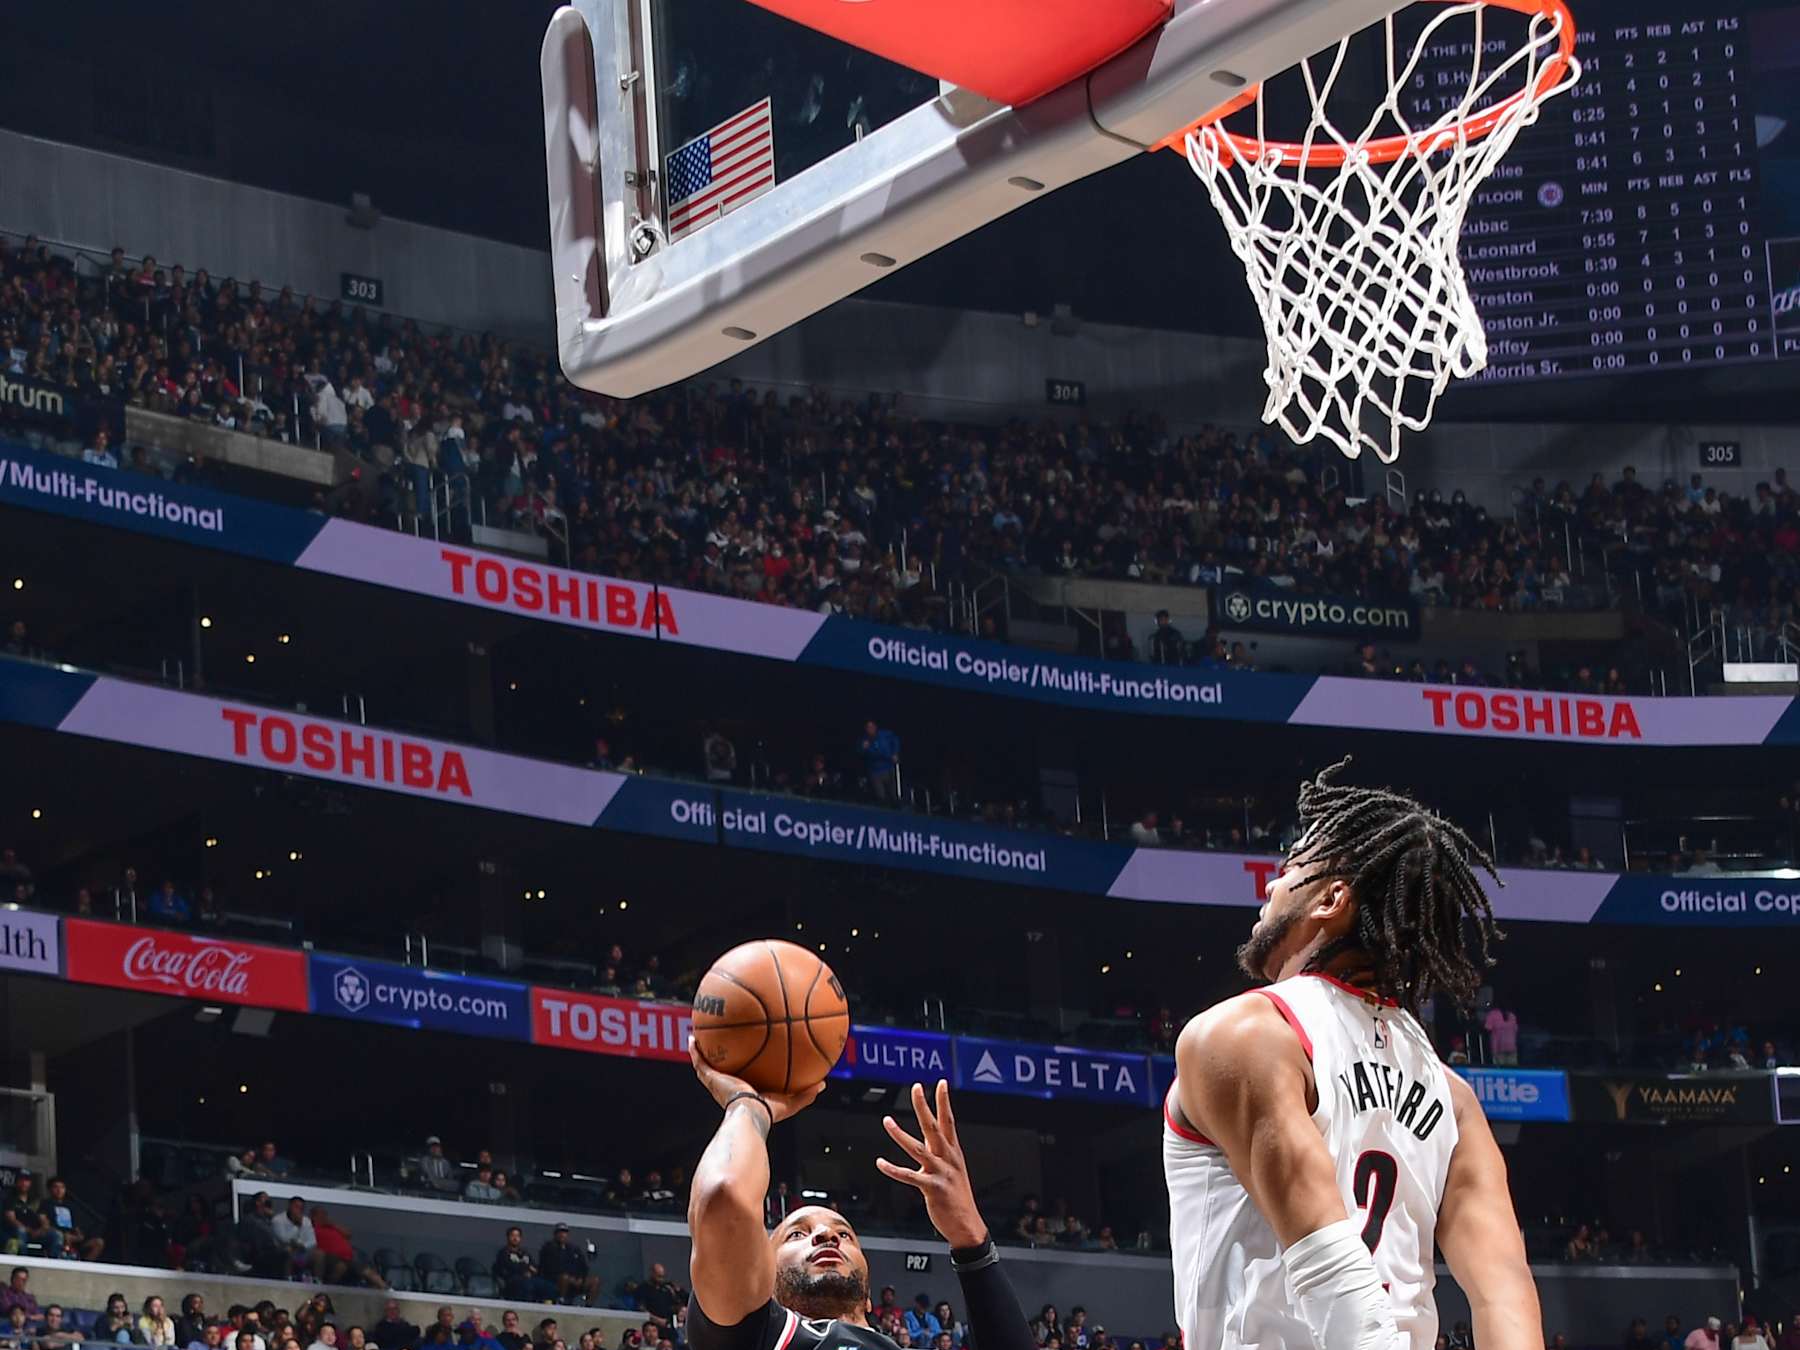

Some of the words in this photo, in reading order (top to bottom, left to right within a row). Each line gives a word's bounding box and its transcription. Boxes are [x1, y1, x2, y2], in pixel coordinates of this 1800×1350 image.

[1431, 44, 1459, 57] THE
[1615, 27, 1639, 40] PTS
[1646, 24, 1671, 38] REB
[1681, 21, 1705, 34] AST
[1716, 18, 1739, 31] FLS
[1415, 74, 1425, 88] 5
[1625, 53, 1634, 67] 2
[1657, 51, 1667, 64] 2
[1692, 48, 1700, 61] 1
[1725, 44, 1734, 57] 0
[1414, 99, 1431, 113] 14
[1627, 79, 1636, 92] 4
[1659, 75, 1668, 88] 0
[1693, 72, 1701, 86] 2
[1728, 69, 1735, 82] 1
[1573, 107, 1605, 123] 6:25
[1629, 104, 1638, 117] 3
[1662, 100, 1670, 114] 1
[1694, 97, 1704, 111] 0
[1730, 94, 1737, 107] 1
[1574, 131, 1606, 147] 8:41
[1631, 127, 1640, 141] 7
[1663, 124, 1672, 137] 0
[1696, 121, 1705, 135] 3
[1732, 118, 1739, 131] 1
[1576, 155, 1608, 171] 8:41
[1633, 151, 1642, 165] 6
[1666, 149, 1674, 162] 3
[1699, 146, 1707, 159] 1
[1734, 142, 1741, 156] 1
[1478, 191, 1523, 204] FLOOR
[1581, 182, 1608, 195] MIN
[1627, 178, 1651, 191] PTS
[1658, 174, 1684, 188] REB
[1694, 171, 1718, 185] AST
[1729, 168, 1751, 182] FLS
[1581, 208, 1613, 224] 7:39
[1703, 199, 1712, 213] 0
[1738, 196, 1746, 210] 1
[1459, 240, 1537, 259] .Leonard
[1583, 233, 1615, 249] 9:55
[1639, 230, 1648, 244] 7
[1672, 227, 1680, 241] 1
[1705, 224, 1714, 238] 3
[1739, 221, 1749, 235] 0
[1585, 256, 1617, 273] 8:39
[1641, 253, 1650, 267] 4
[1674, 250, 1683, 264] 3
[1708, 248, 1715, 262] 1
[1741, 245, 1751, 259] 0
[348, 279, 377, 299] 303
[1472, 290, 1533, 307] Preston
[1586, 281, 1619, 297] 0:00
[1643, 278, 1652, 293] 0
[1676, 275, 1686, 289] 0
[1709, 272, 1718, 287] 0
[1743, 269, 1753, 283] 0
[1539, 312, 1559, 327] Jr.
[1588, 306, 1621, 322] 0:00
[1645, 303, 1654, 317] 0
[1678, 300, 1687, 314] 0
[1711, 297, 1721, 311] 0
[1746, 294, 1755, 308] 0
[1590, 330, 1623, 346] 0:00
[1647, 327, 1657, 342] 0
[1680, 324, 1689, 339] 0
[1713, 321, 1723, 336] 0
[1748, 318, 1757, 333] 0
[1540, 359, 1562, 375] Sr.
[1592, 354, 1625, 370] 0:00
[1649, 351, 1659, 366] 0
[1682, 348, 1692, 363] 0
[1715, 345, 1725, 360] 0
[1750, 342, 1759, 357] 0
[0, 374, 63, 415] trum
[1053, 384, 1080, 401] 304
[1707, 447, 1734, 462] 305
[441, 549, 680, 635] TOSHIBA
[1256, 599, 1409, 629] crypto.com
[868, 636, 949, 670] Official
[1422, 689, 1642, 740] TOSHIBA
[222, 708, 473, 797] TOSHIBA
[671, 798, 766, 834] Official
[1660, 890, 1747, 912] Official
[0, 925, 47, 960] lth
[124, 937, 253, 995] Coca-Cola
[375, 982, 508, 1019] crypto.com
[862, 1043, 944, 1071] ULTRA
[1015, 1055, 1136, 1094] DELTA
[1353, 1149, 1398, 1264] 2
[907, 1255, 929, 1270] PR7
